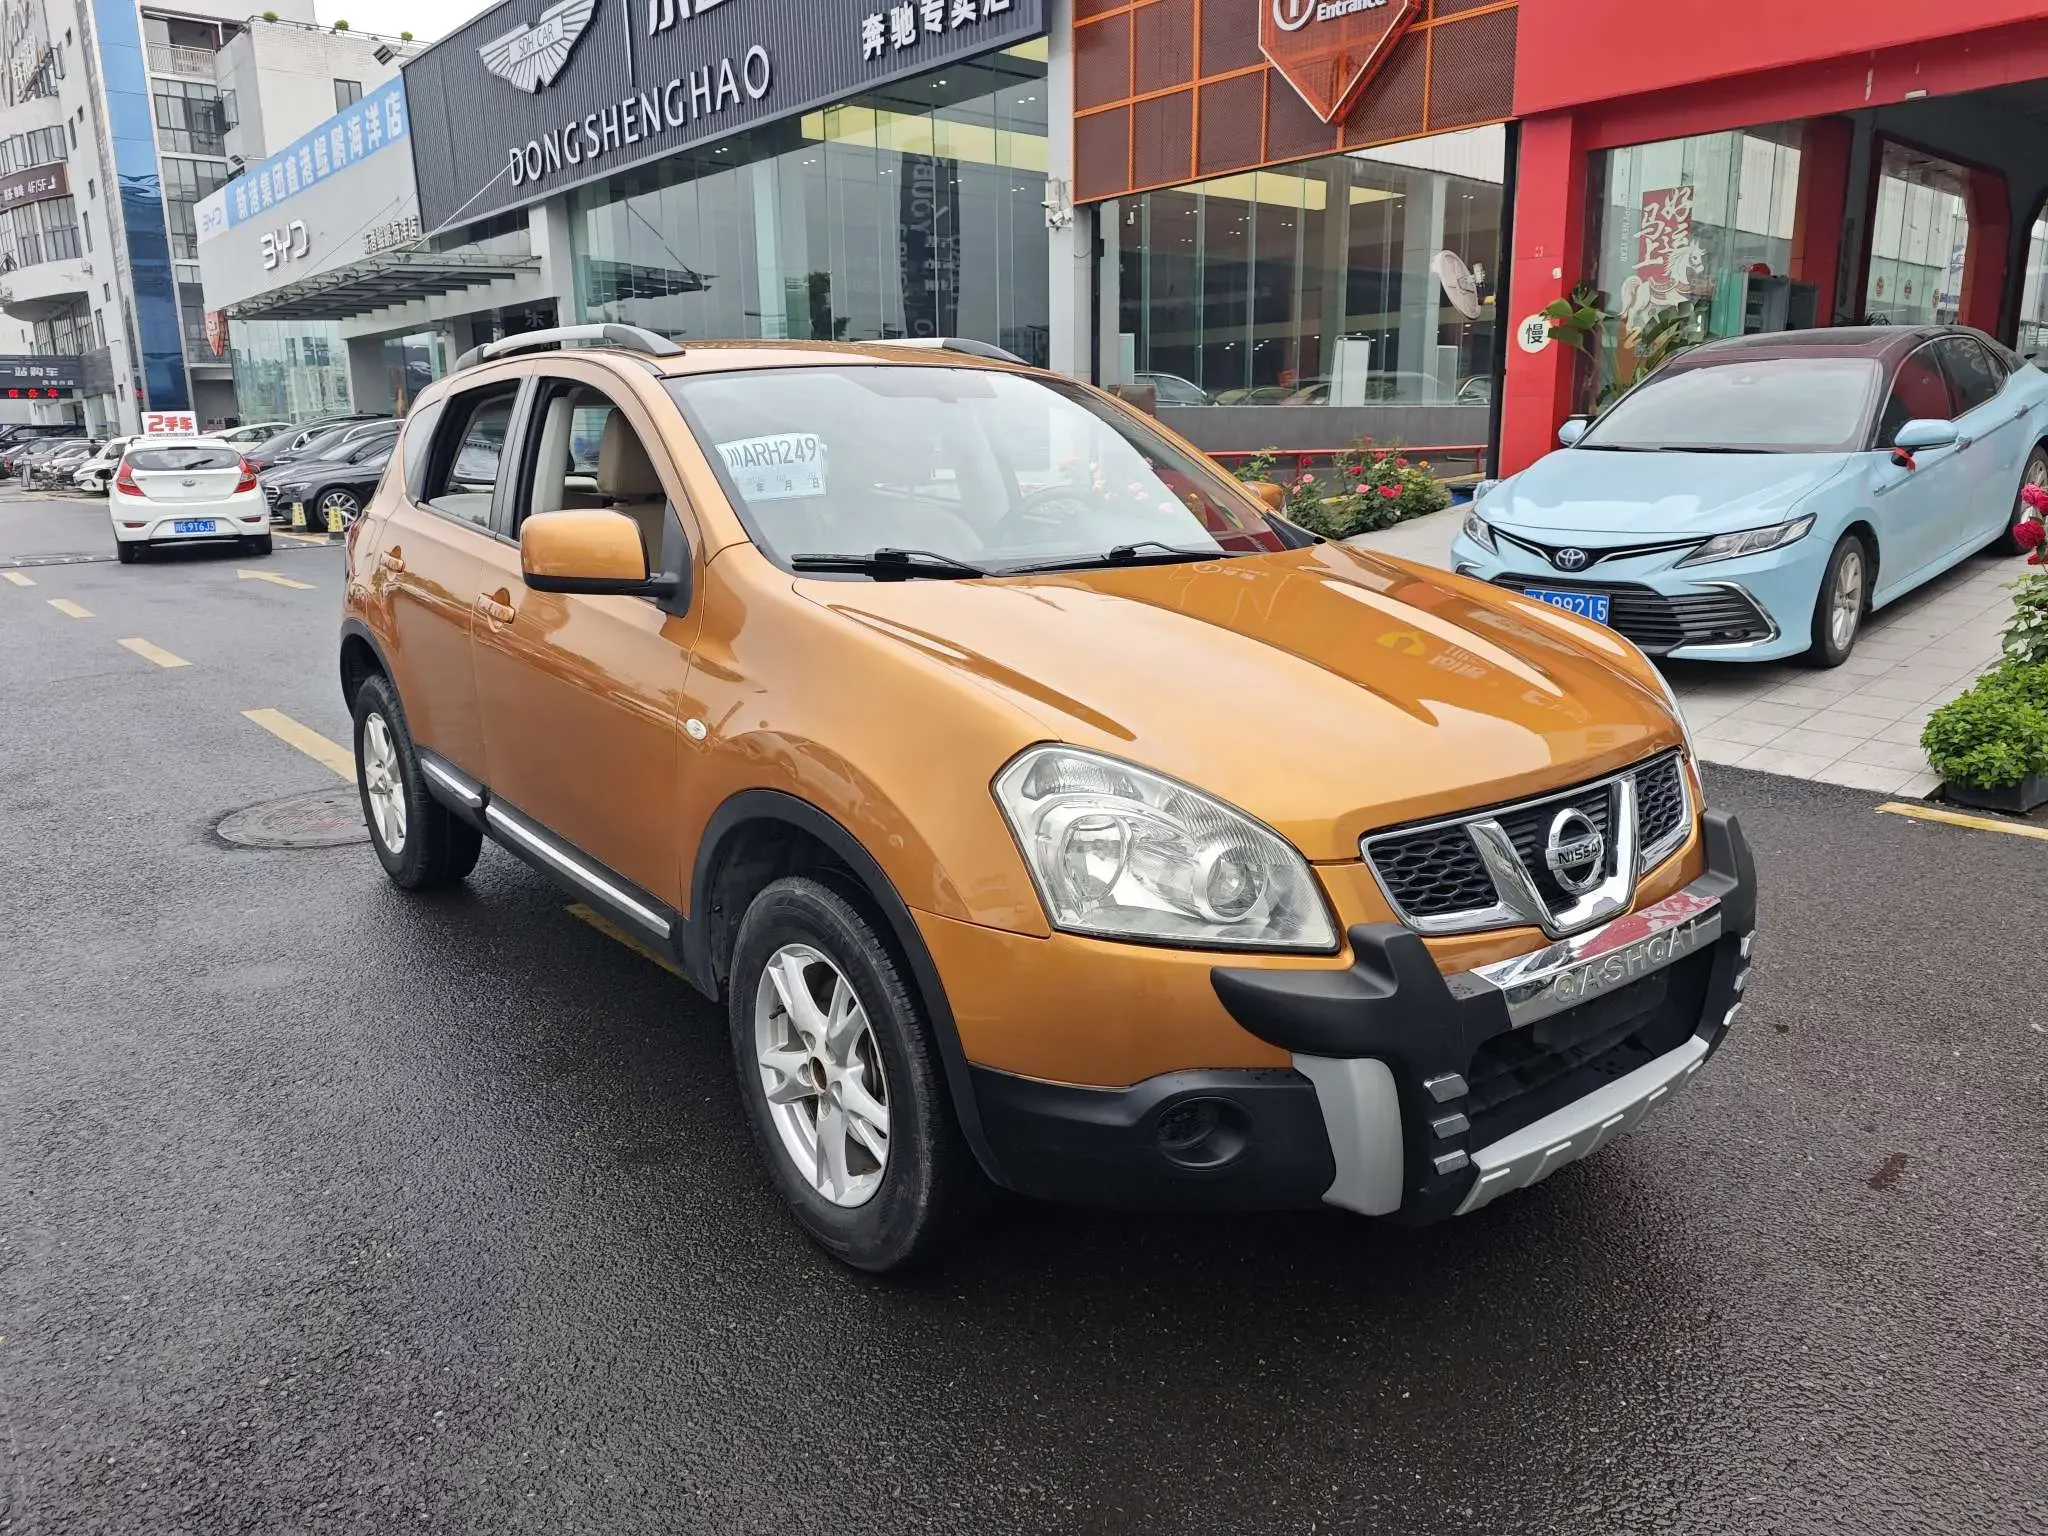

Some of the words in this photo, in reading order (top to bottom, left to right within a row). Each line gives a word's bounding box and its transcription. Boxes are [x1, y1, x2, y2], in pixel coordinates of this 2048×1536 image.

[518, 34, 534, 58] SDH
[536, 23, 555, 49] CAR
[509, 44, 771, 187] DONGSHENGHAO
[1525, 323, 1543, 345] 慢
[147, 414, 193, 433] 2手车
[726, 437, 816, 468] 川ARH249
[785, 480, 792, 492] 月
[813, 477, 820, 489] 日
[1553, 919, 1697, 1001] QASHQAI
